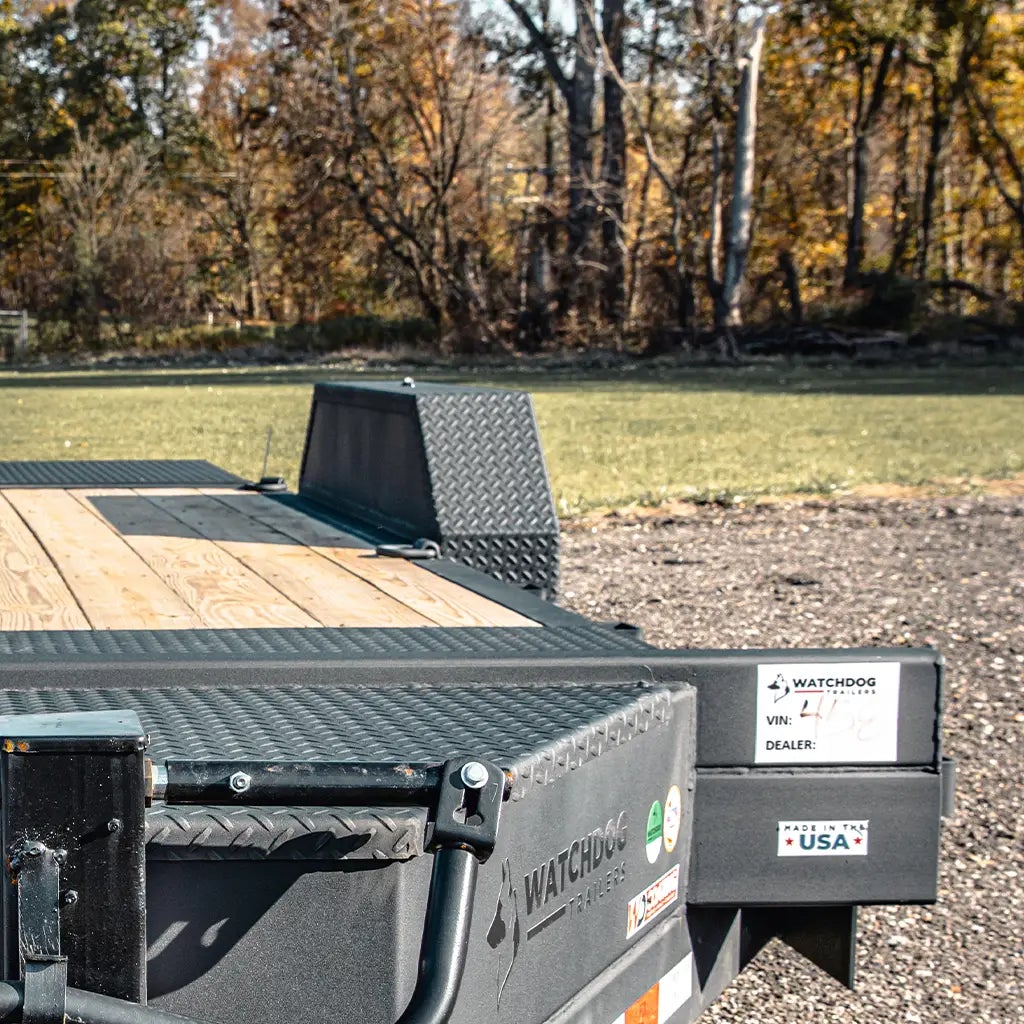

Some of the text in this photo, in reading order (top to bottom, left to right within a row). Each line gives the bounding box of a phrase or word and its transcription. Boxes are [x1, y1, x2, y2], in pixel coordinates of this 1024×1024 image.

[792, 677, 876, 688] WATCHDOG
[766, 715, 792, 726] VIN:
[766, 739, 816, 751] DEALER:
[799, 833, 851, 850] USA
[524, 810, 628, 916] WATCHDOG
[568, 861, 627, 920] TRAILERS
